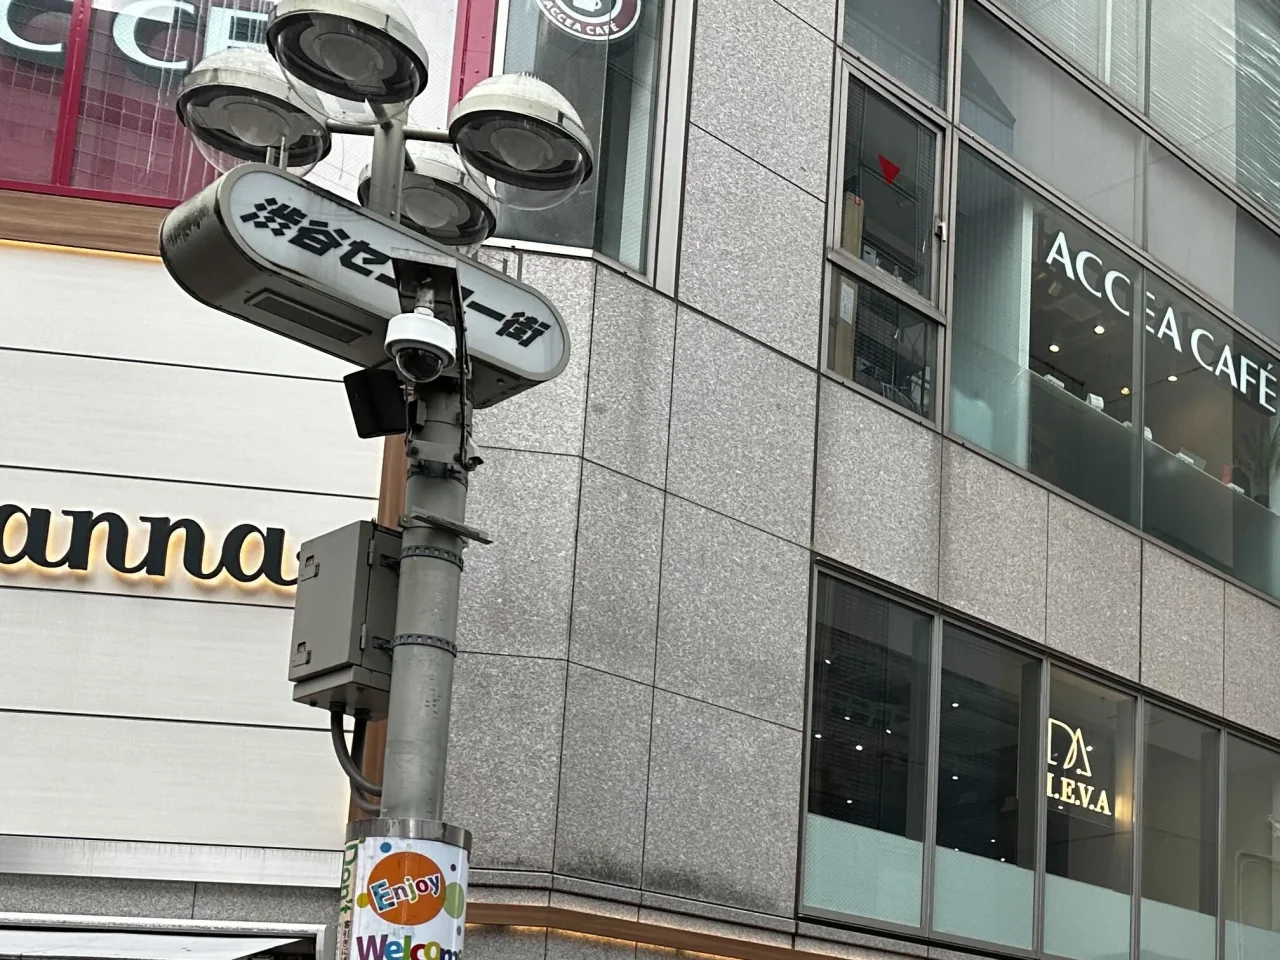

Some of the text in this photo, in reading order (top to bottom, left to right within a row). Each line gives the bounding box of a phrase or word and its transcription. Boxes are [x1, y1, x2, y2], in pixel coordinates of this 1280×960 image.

[543, 0, 619, 35] ACCEA CAFÉ
[240, 198, 552, 348] 渋谷セー街
[1190, 328, 1277, 414] CAFÉ
[0, 503, 301, 587] anna
[370, 873, 442, 913] Enjoy
